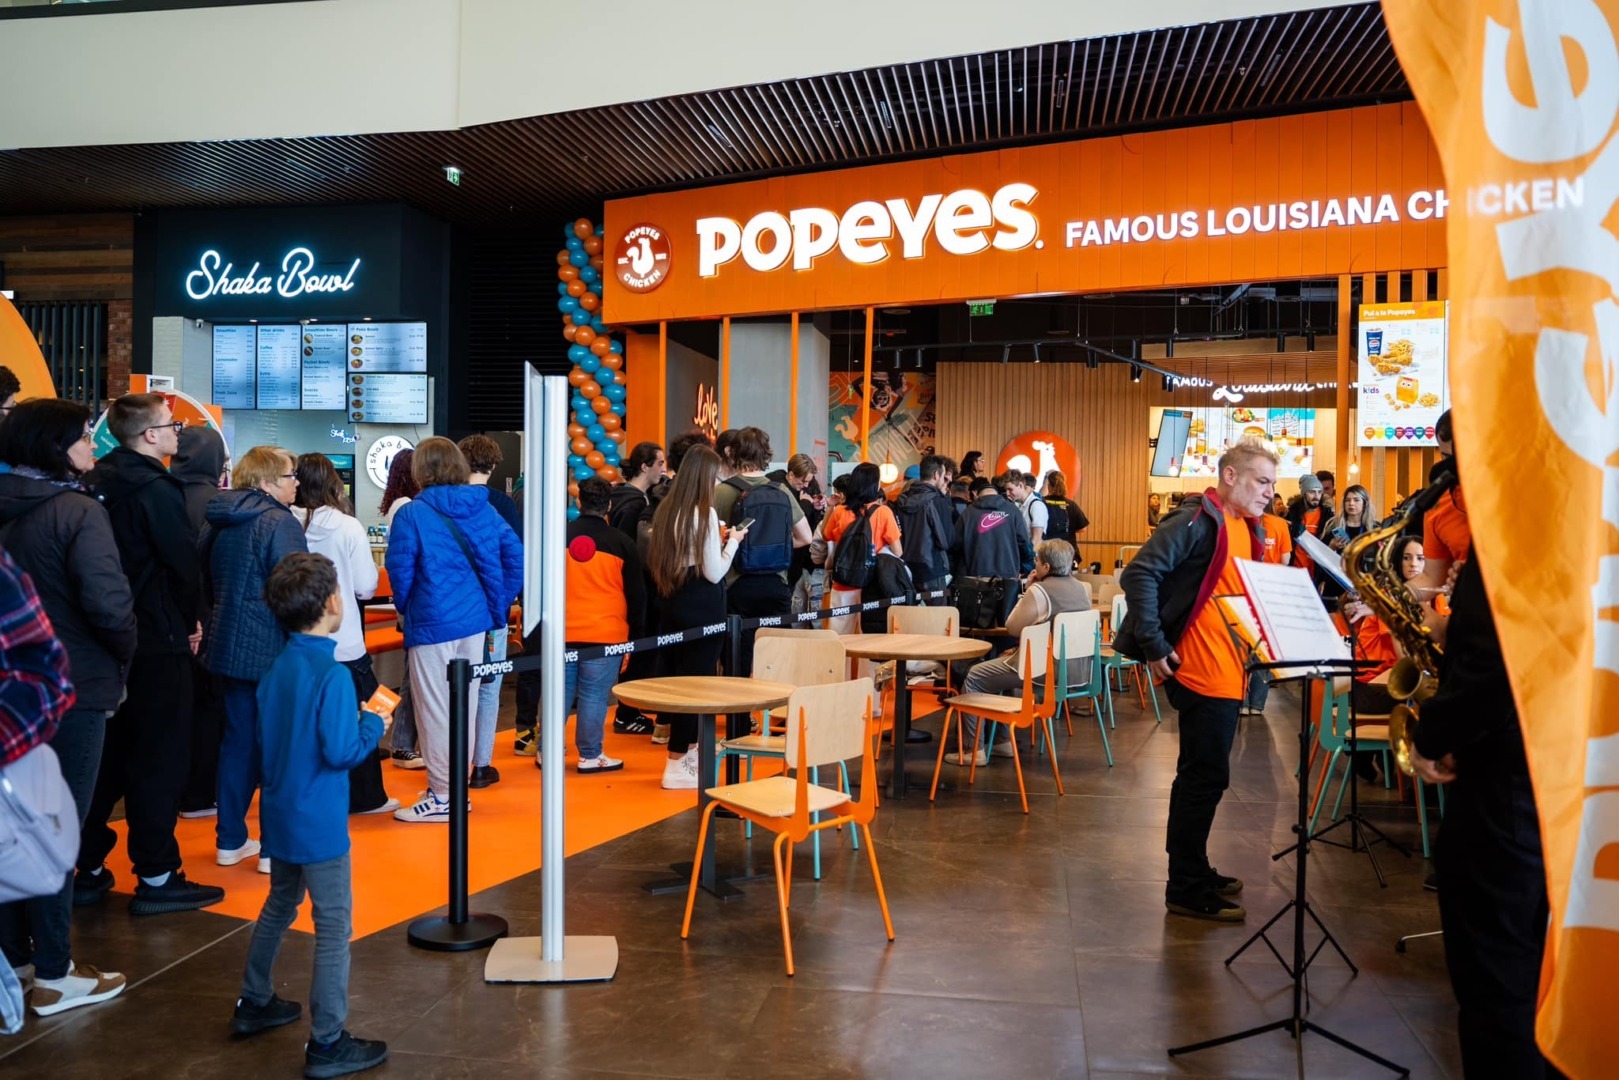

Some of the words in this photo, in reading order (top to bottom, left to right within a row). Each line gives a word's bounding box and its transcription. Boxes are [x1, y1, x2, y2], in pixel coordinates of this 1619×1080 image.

[1065, 210, 1199, 248] FAMOUS
[1206, 193, 1400, 237] LOUISIANA
[624, 226, 660, 244] POPEYES
[186, 249, 272, 300] Shaka
[277, 247, 361, 298] Bowl
[623, 269, 661, 288] CHICKEN
[370, 441, 392, 464] shaka
[797, 611, 818, 622] POPEYES
[832, 606, 850, 616] POPEYES
[703, 622, 727, 636] POPEYES
[759, 617, 782, 627] POPEYES
[657, 632, 684, 646] POPEYES
[604, 641, 635, 656] POPEYES
[473, 660, 514, 678] POPEYES
